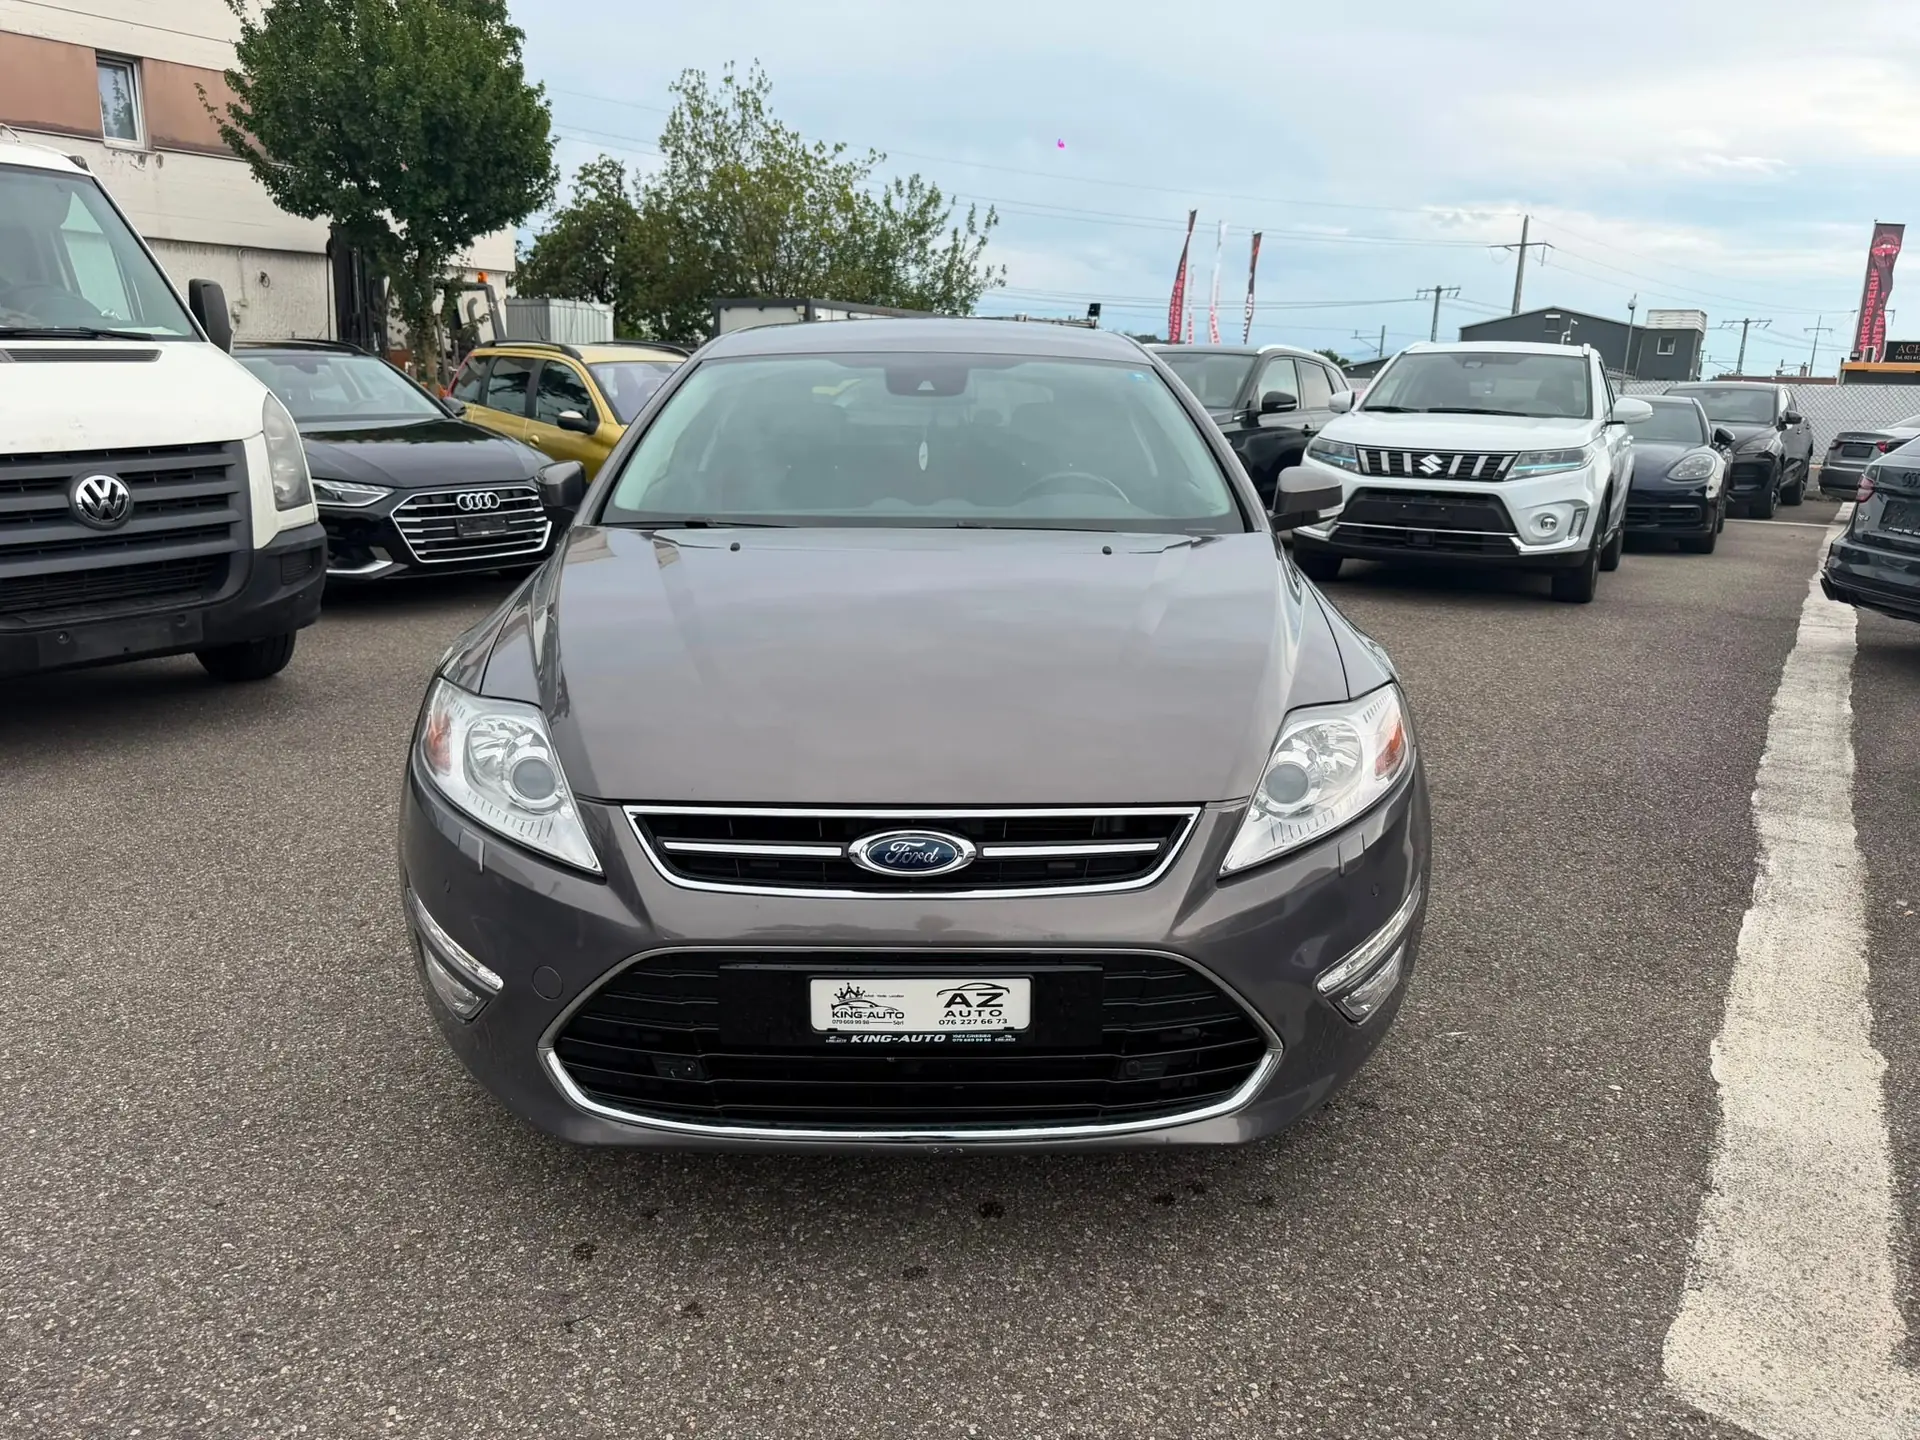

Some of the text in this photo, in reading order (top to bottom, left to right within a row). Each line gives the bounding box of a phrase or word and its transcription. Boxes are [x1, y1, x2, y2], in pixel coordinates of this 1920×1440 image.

[1858, 268, 1879, 352] ARROSSERIE
[885, 841, 940, 864] Ford
[944, 992, 1004, 1008] AZ
[832, 1011, 905, 1019] KING-AUTO
[944, 1010, 1003, 1018] AUTO
[850, 1034, 946, 1043] KING-AUTO
